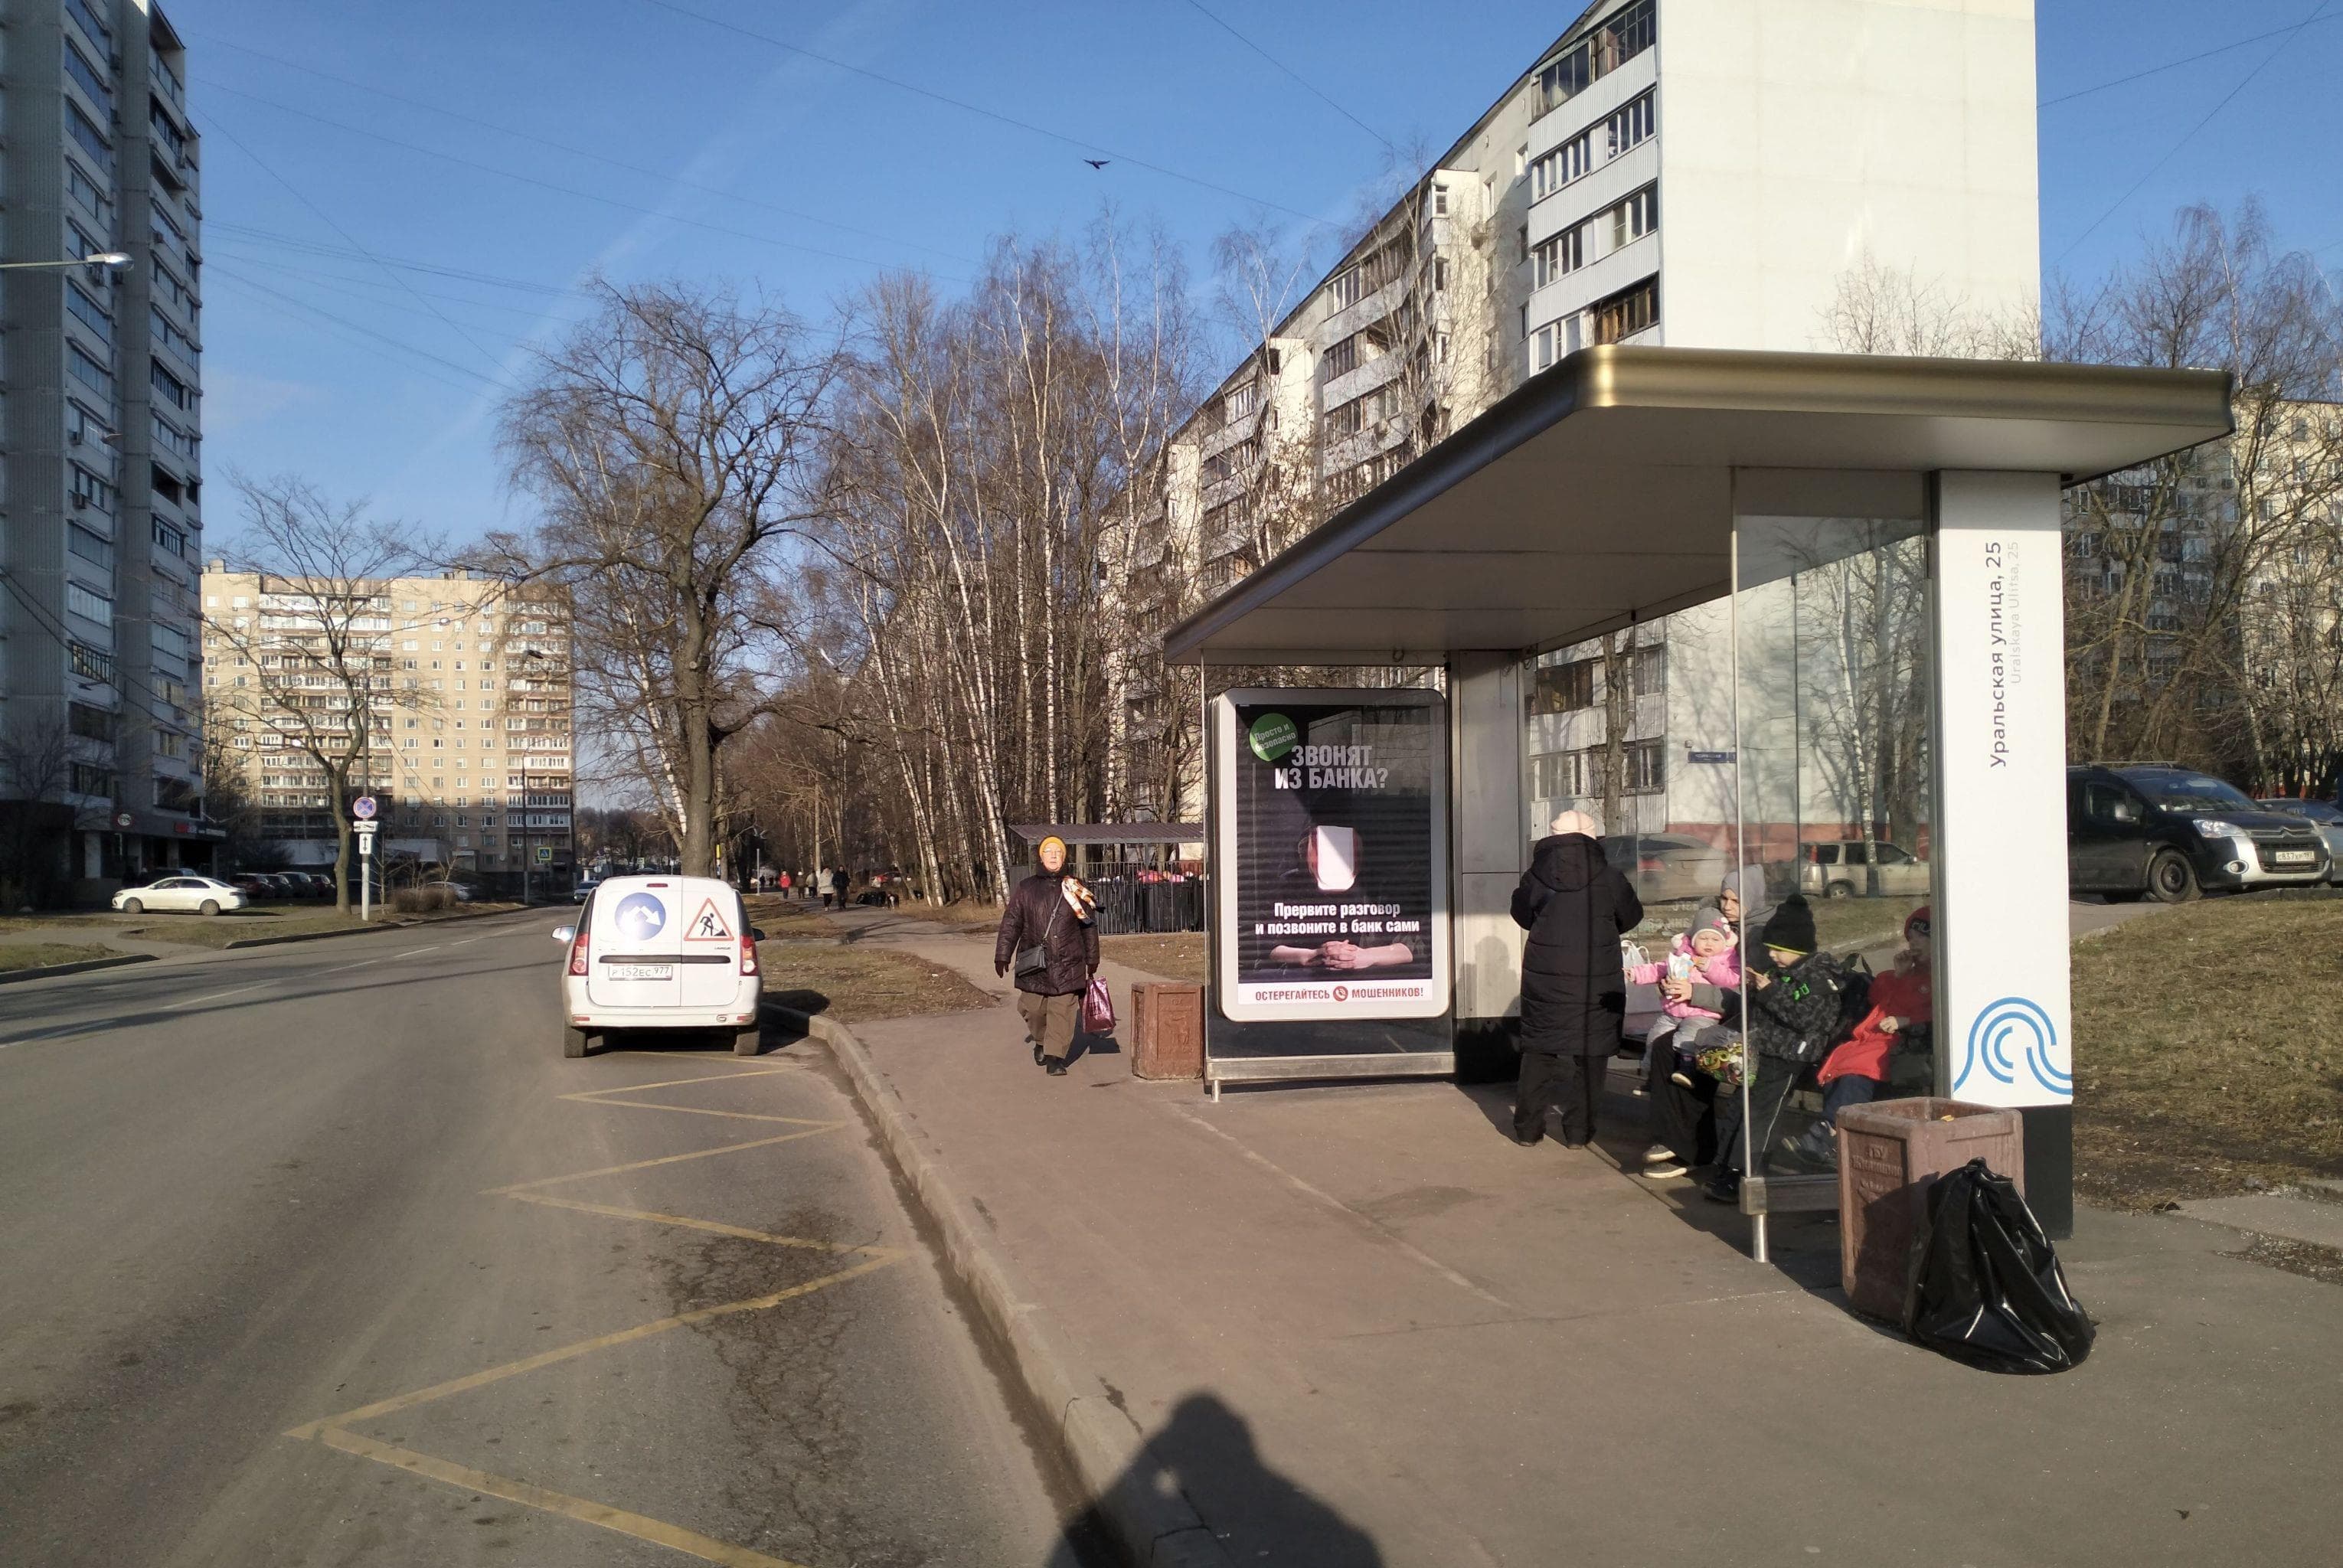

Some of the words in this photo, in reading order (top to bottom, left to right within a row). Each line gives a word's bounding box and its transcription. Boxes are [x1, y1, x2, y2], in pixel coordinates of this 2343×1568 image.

[1985, 541, 2002, 568] 25
[2008, 541, 2019, 560] 25
[2008, 564, 2021, 609] Ulitsa,
[1990, 575, 2007, 645] улица,
[2008, 613, 2022, 684] Uralskaya
[1990, 652, 2009, 768] Уральская
[1253, 727, 1283, 742] Просто
[1283, 724, 1290, 733] и
[1254, 732, 1297, 752] безопасно
[1291, 745, 1373, 766] ЗВОНЯТ
[1275, 767, 1302, 789] ИЗ
[1309, 767, 1389, 789] БАНКА?
[1274, 902, 1337, 919] Прервите
[1340, 903, 1400, 919] разговор
[1255, 923, 1264, 935] и
[1267, 921, 1336, 934] позвоните
[1340, 922, 1348, 933] в
[1351, 919, 1383, 933] банк
[1386, 920, 1420, 932] сами
[1255, 988, 1330, 1001] ОСТЕРЕГАЙТЕСЬ
[1351, 987, 1423, 998] МОШЕННИКОВ!
